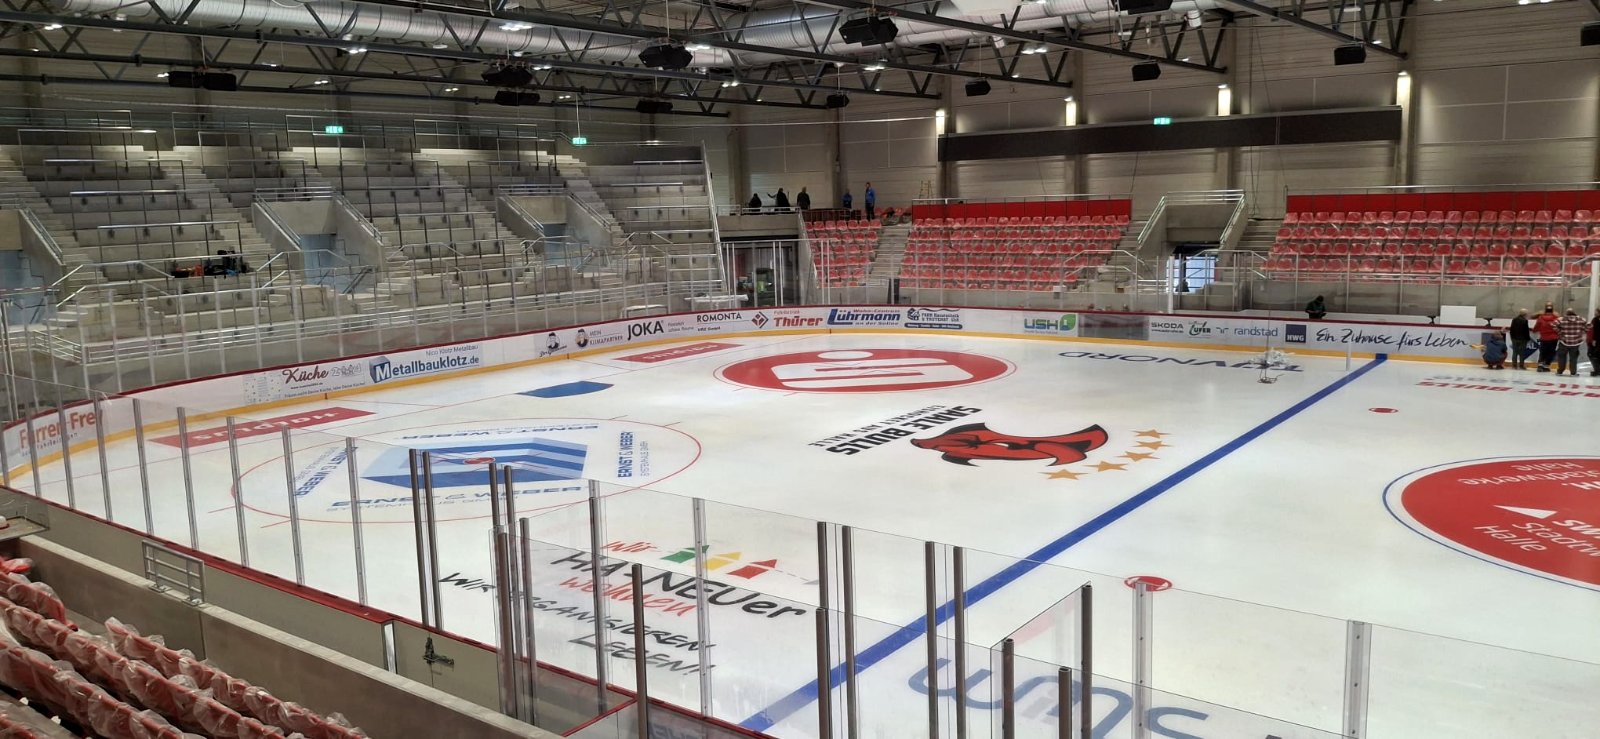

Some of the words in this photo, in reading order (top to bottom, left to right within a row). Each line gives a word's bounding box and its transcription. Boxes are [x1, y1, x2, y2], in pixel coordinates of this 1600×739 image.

[696, 312, 743, 323] ROMONTA
[773, 314, 824, 327] Thürer
[827, 308, 901, 326] Lührmann
[1023, 318, 1059, 330] USH
[627, 320, 664, 341] JOKA
[1234, 326, 1279, 337] randstad
[1316, 328, 1336, 342] Ein
[1341, 328, 1397, 345] Zuhause
[282, 364, 330, 385] Küche
[374, 354, 480, 383] Metallbauklotz.de
[1518, 388, 1600, 398] AALE
[902, 405, 983, 430] SAALE
[619, 431, 634, 451] WEBER
[825, 427, 917, 456] BULLS
[617, 455, 633, 478] ERNST
[1511, 461, 1585, 471] Halle
[1473, 525, 1548, 552] Halle
[1512, 522, 1600, 557] Stadtw
[1552, 519, 1600, 540] SW
[550, 551, 807, 619] HA-NEUer
